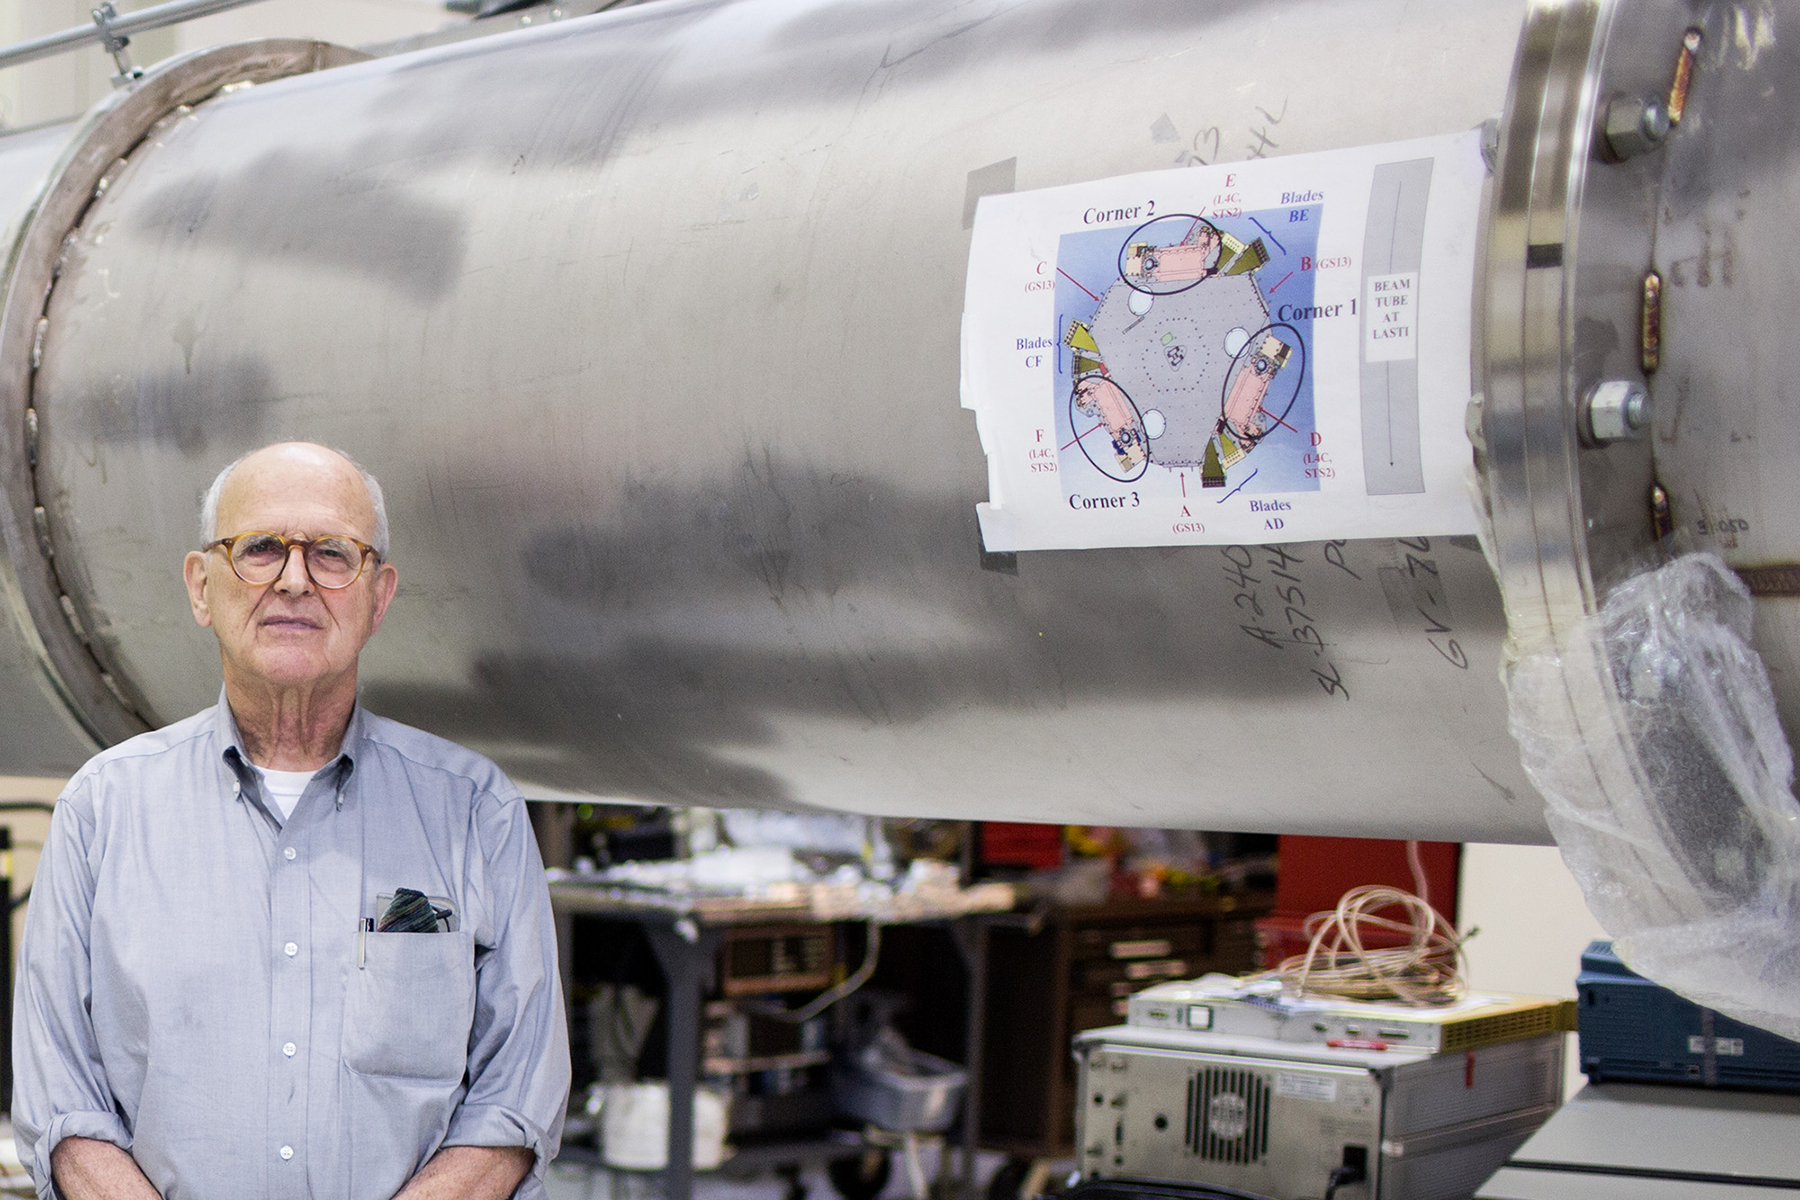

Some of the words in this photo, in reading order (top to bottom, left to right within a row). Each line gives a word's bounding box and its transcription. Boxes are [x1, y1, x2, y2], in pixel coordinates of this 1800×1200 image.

[1225, 173, 1236, 188] E
[1213, 192, 1242, 206] (L4C,
[1280, 190, 1324, 204] Blades
[1083, 206, 1141, 225] Corner
[1146, 199, 1156, 217] 2
[1212, 207, 1242, 220] STS2)
[1289, 208, 1310, 222] BE
[1036, 261, 1047, 275] C
[1301, 256, 1312, 272] B
[1316, 256, 1352, 271] (GS13)
[1024, 280, 1056, 293] (GS13)
[1374, 279, 1411, 292] BEAM
[1375, 295, 1409, 308] TUBE
[1278, 303, 1343, 322] Corner
[1350, 298, 1358, 316] 1
[1382, 312, 1400, 323] AT
[1373, 326, 1409, 340] LASTI
[1016, 337, 1053, 350] Blades
[1025, 355, 1042, 368] CF
[1036, 429, 1044, 443] F
[1311, 432, 1322, 446] D
[1029, 448, 1054, 460] (L4C,
[1303, 452, 1333, 466] (L4C,
[1031, 462, 1058, 473] STS2)
[1305, 467, 1335, 479] STS2)
[1069, 493, 1126, 510] Corner
[1131, 491, 1140, 507] 3
[1250, 500, 1292, 512] Blades
[1180, 505, 1191, 518] A
[1172, 522, 1205, 534] (GS13)
[1263, 518, 1284, 531] AD
